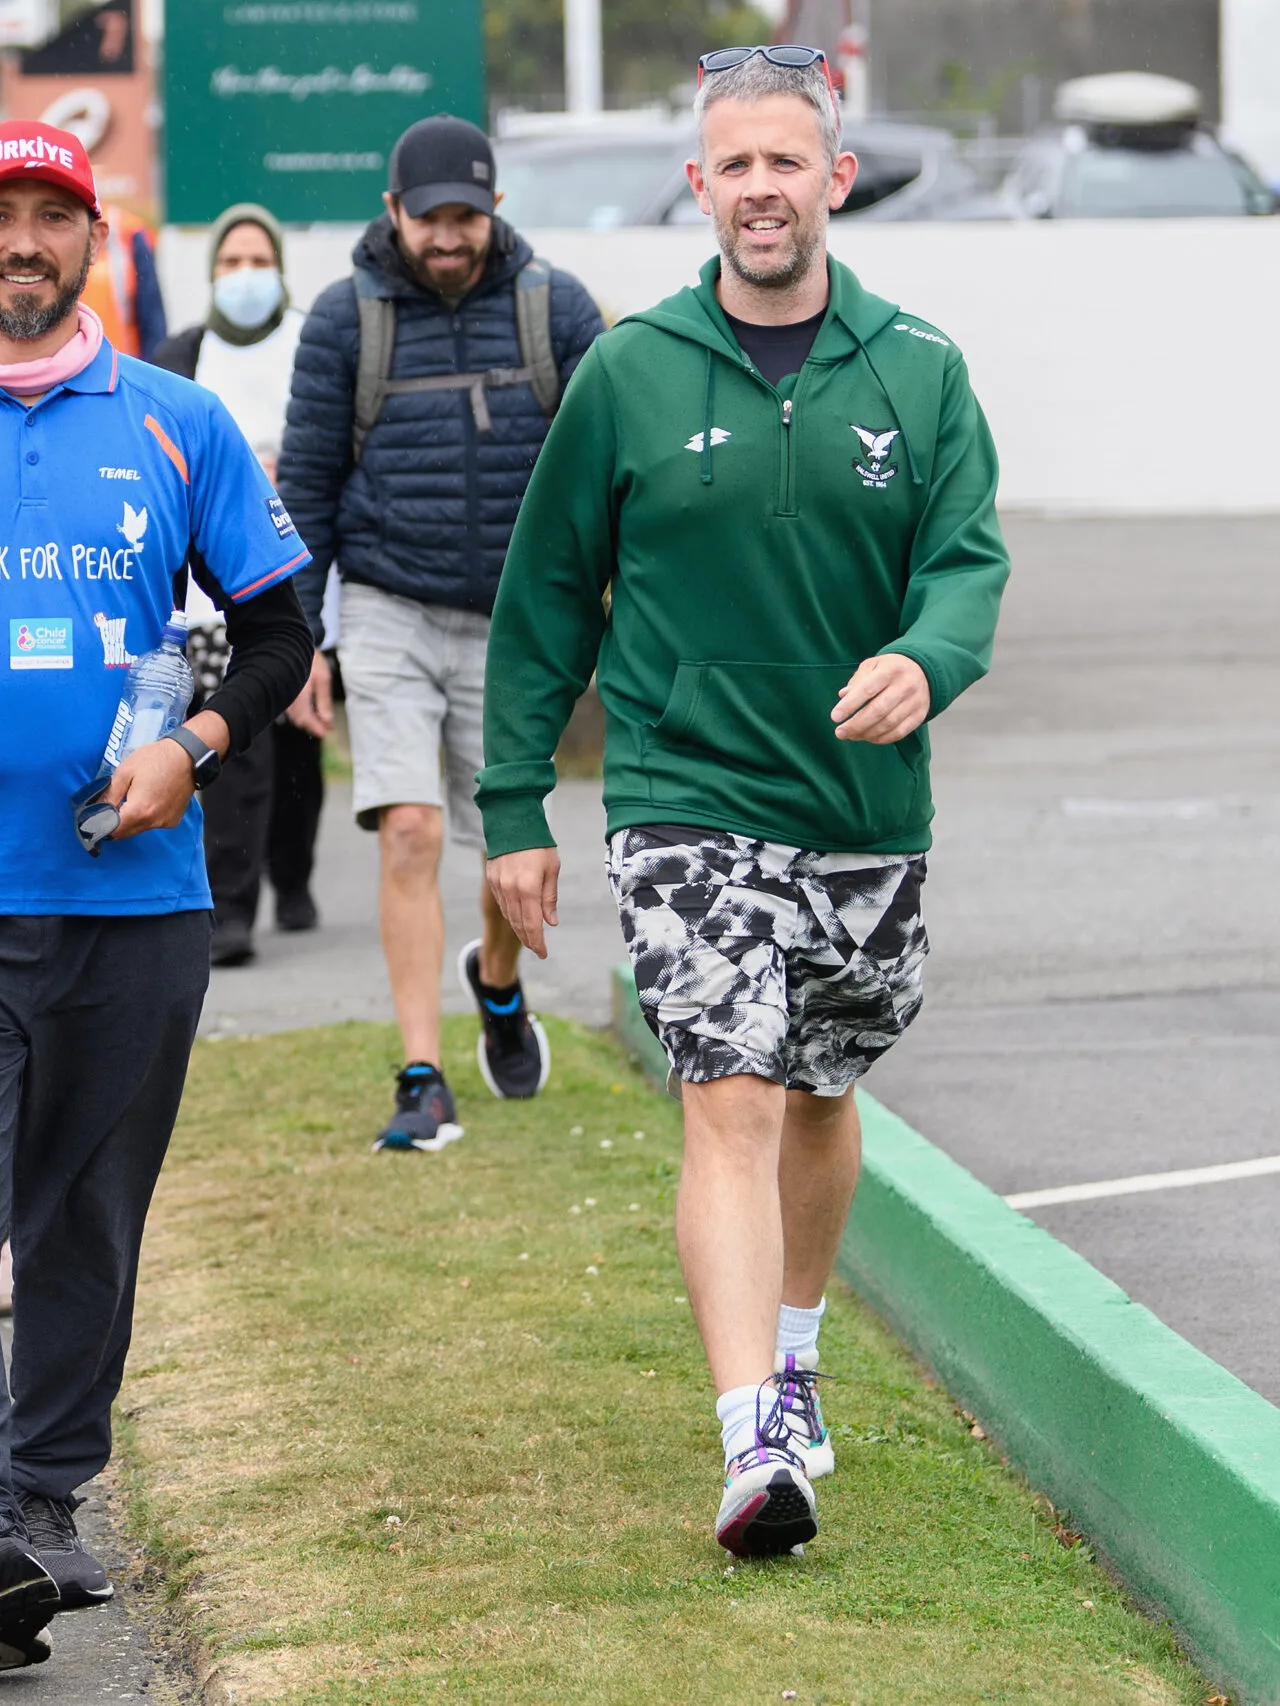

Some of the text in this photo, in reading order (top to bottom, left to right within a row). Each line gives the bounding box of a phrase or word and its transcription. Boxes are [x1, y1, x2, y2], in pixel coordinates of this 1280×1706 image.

[99, 467, 141, 480] TEMEL
[20, 542, 63, 580] FOR
[72, 543, 134, 580] PEACE
[35, 627, 67, 638] Child
